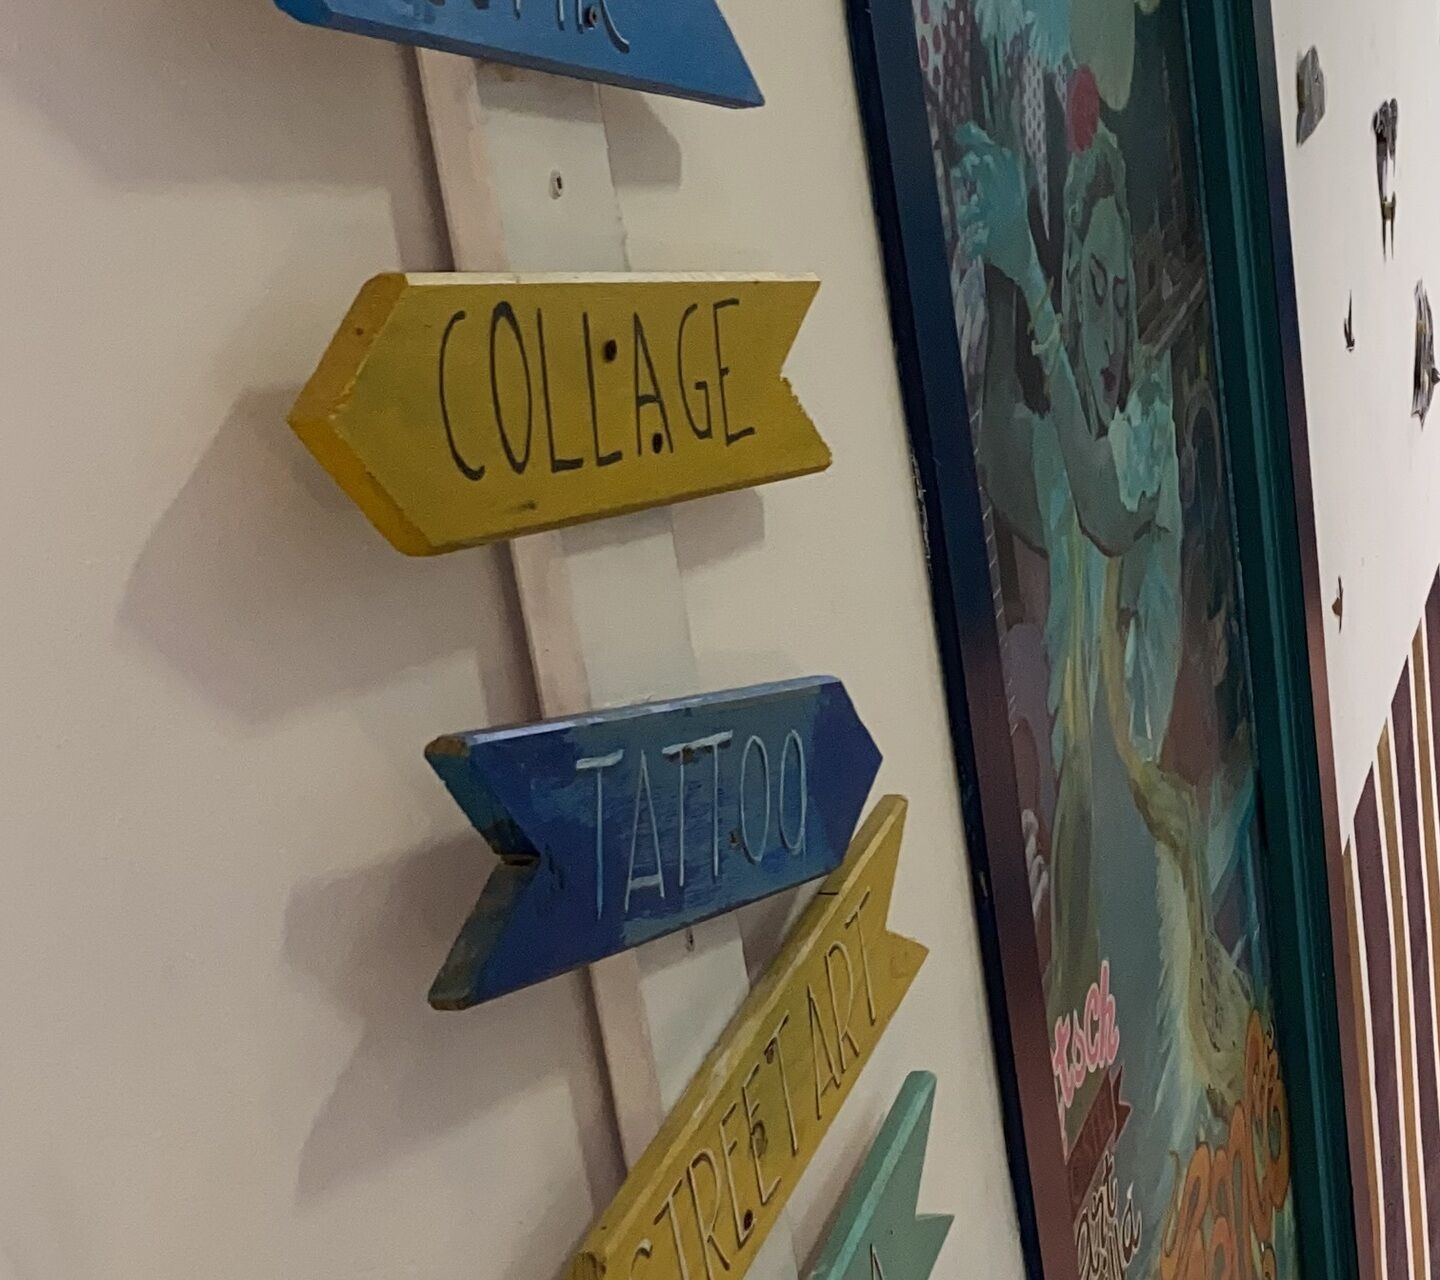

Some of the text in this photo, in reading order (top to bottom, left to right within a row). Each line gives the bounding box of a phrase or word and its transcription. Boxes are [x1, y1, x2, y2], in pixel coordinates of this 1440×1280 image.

[438, 298, 756, 482] COLLAGE
[575, 729, 808, 916] TATTOO
[805, 887, 879, 1121] ART
